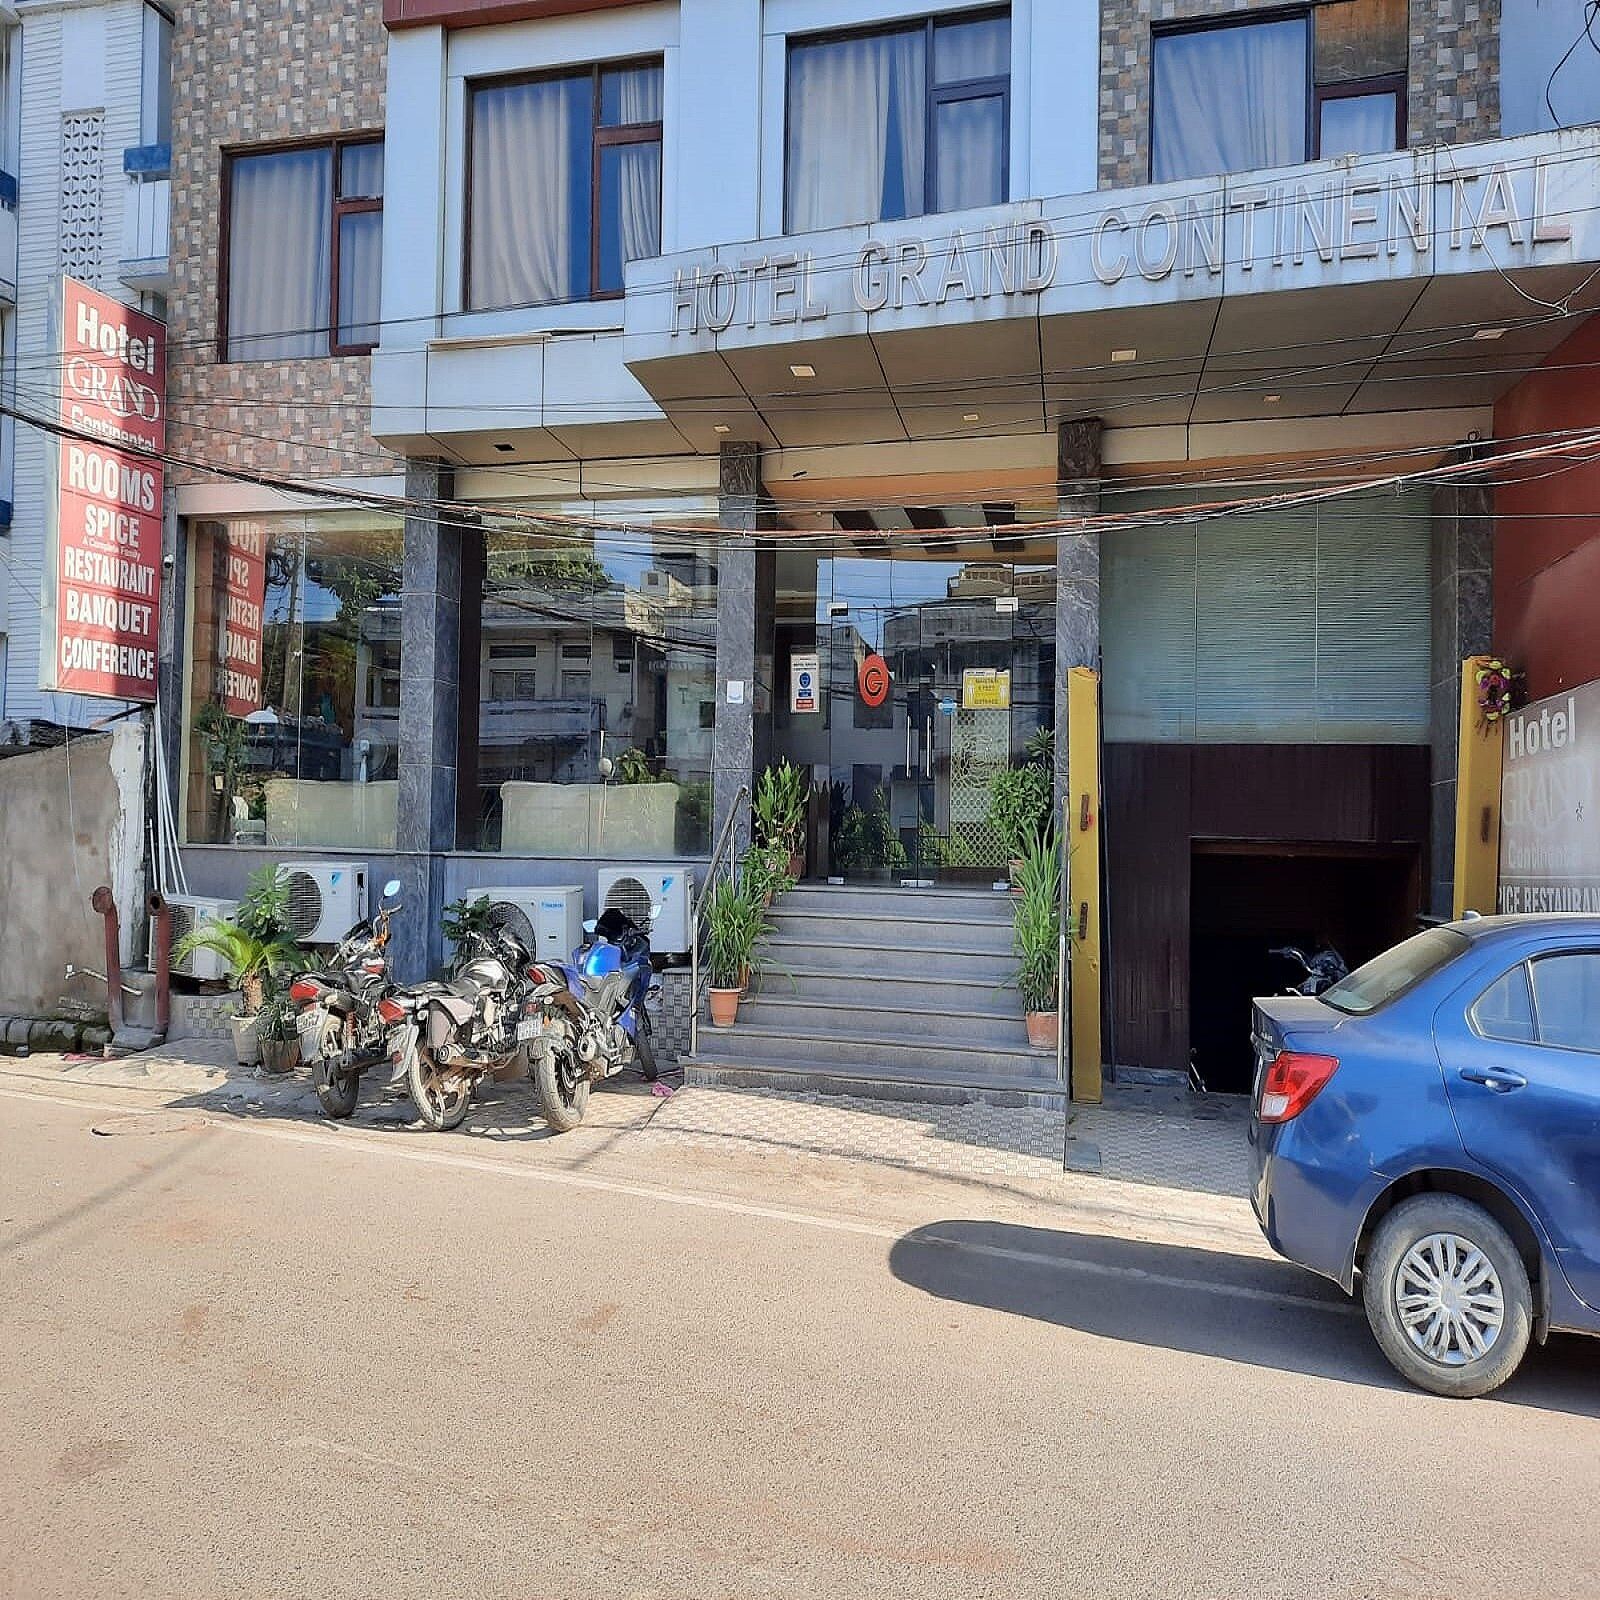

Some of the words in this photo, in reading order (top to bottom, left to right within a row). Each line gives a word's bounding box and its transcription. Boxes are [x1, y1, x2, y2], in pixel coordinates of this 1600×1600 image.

[670, 248, 828, 337] HOTEL
[852, 219, 1059, 312] GRAND
[1091, 155, 1573, 284] CONTINENTAL
[77, 301, 155, 375] Hotel
[67, 357, 160, 422] GRAND
[68, 447, 155, 512] ROOMS
[85, 503, 140, 548] SPICE
[64, 545, 155, 597] RESTAURANT
[66, 589, 152, 636] BANQUET
[61, 635, 155, 681] CONFERENCE
[1509, 696, 1576, 760] Hotel
